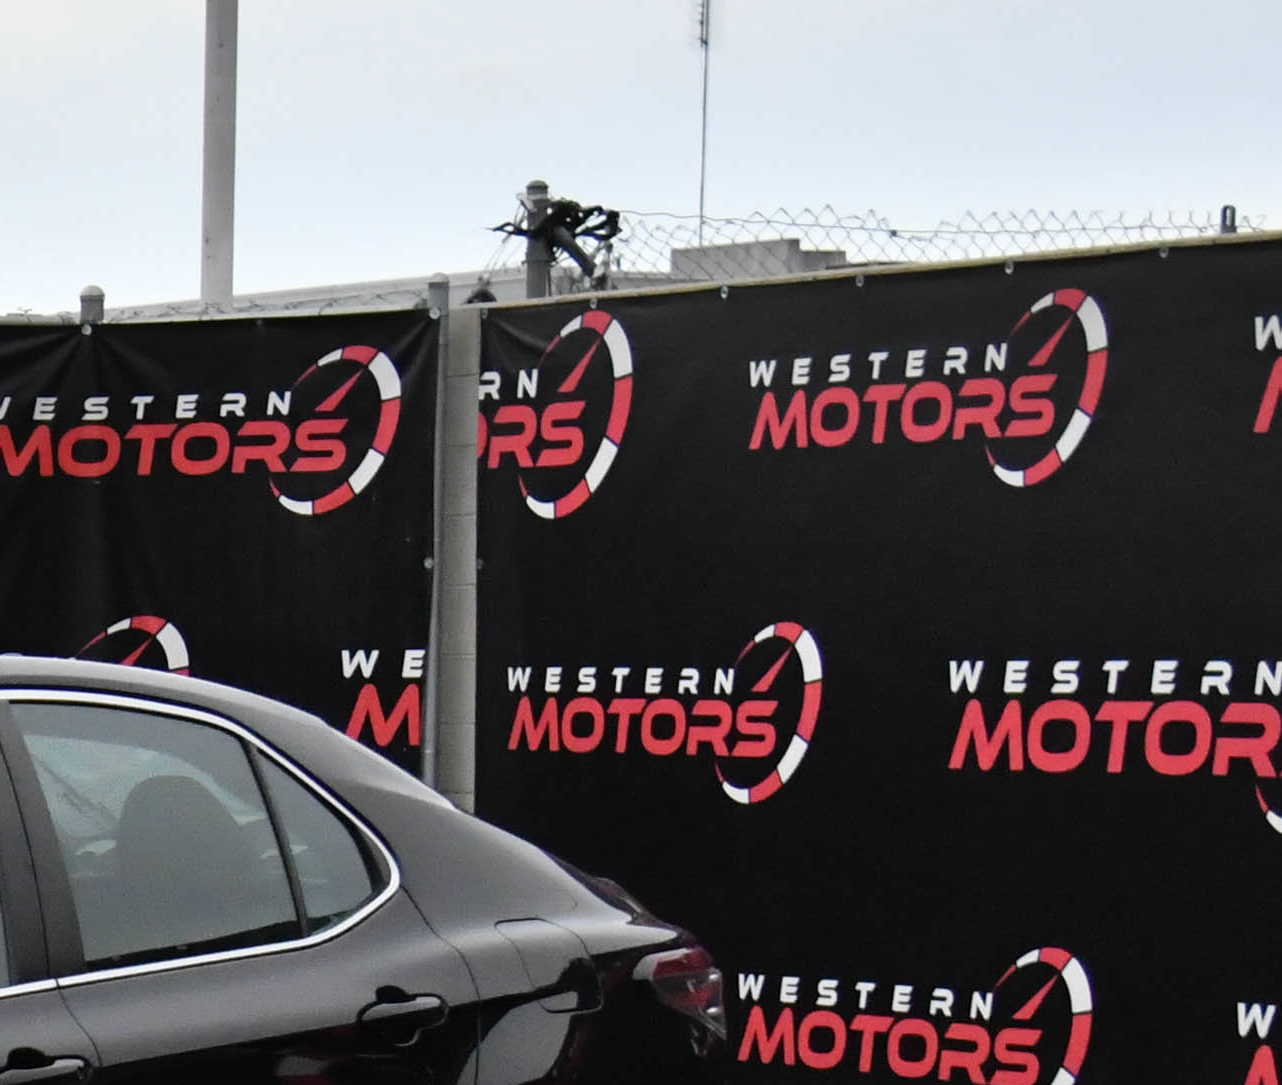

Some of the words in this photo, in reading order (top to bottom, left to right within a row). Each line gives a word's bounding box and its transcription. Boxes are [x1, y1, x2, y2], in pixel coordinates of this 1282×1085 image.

[749, 342, 1008, 388] WESTERN
[749, 373, 1058, 451] MOTORS
[507, 666, 735, 695] WESTERN
[949, 660, 1282, 696] WESTERN
[508, 696, 779, 758] MOTORS
[948, 698, 1282, 778] MOTOR
[738, 973, 993, 1020] WESTERN
